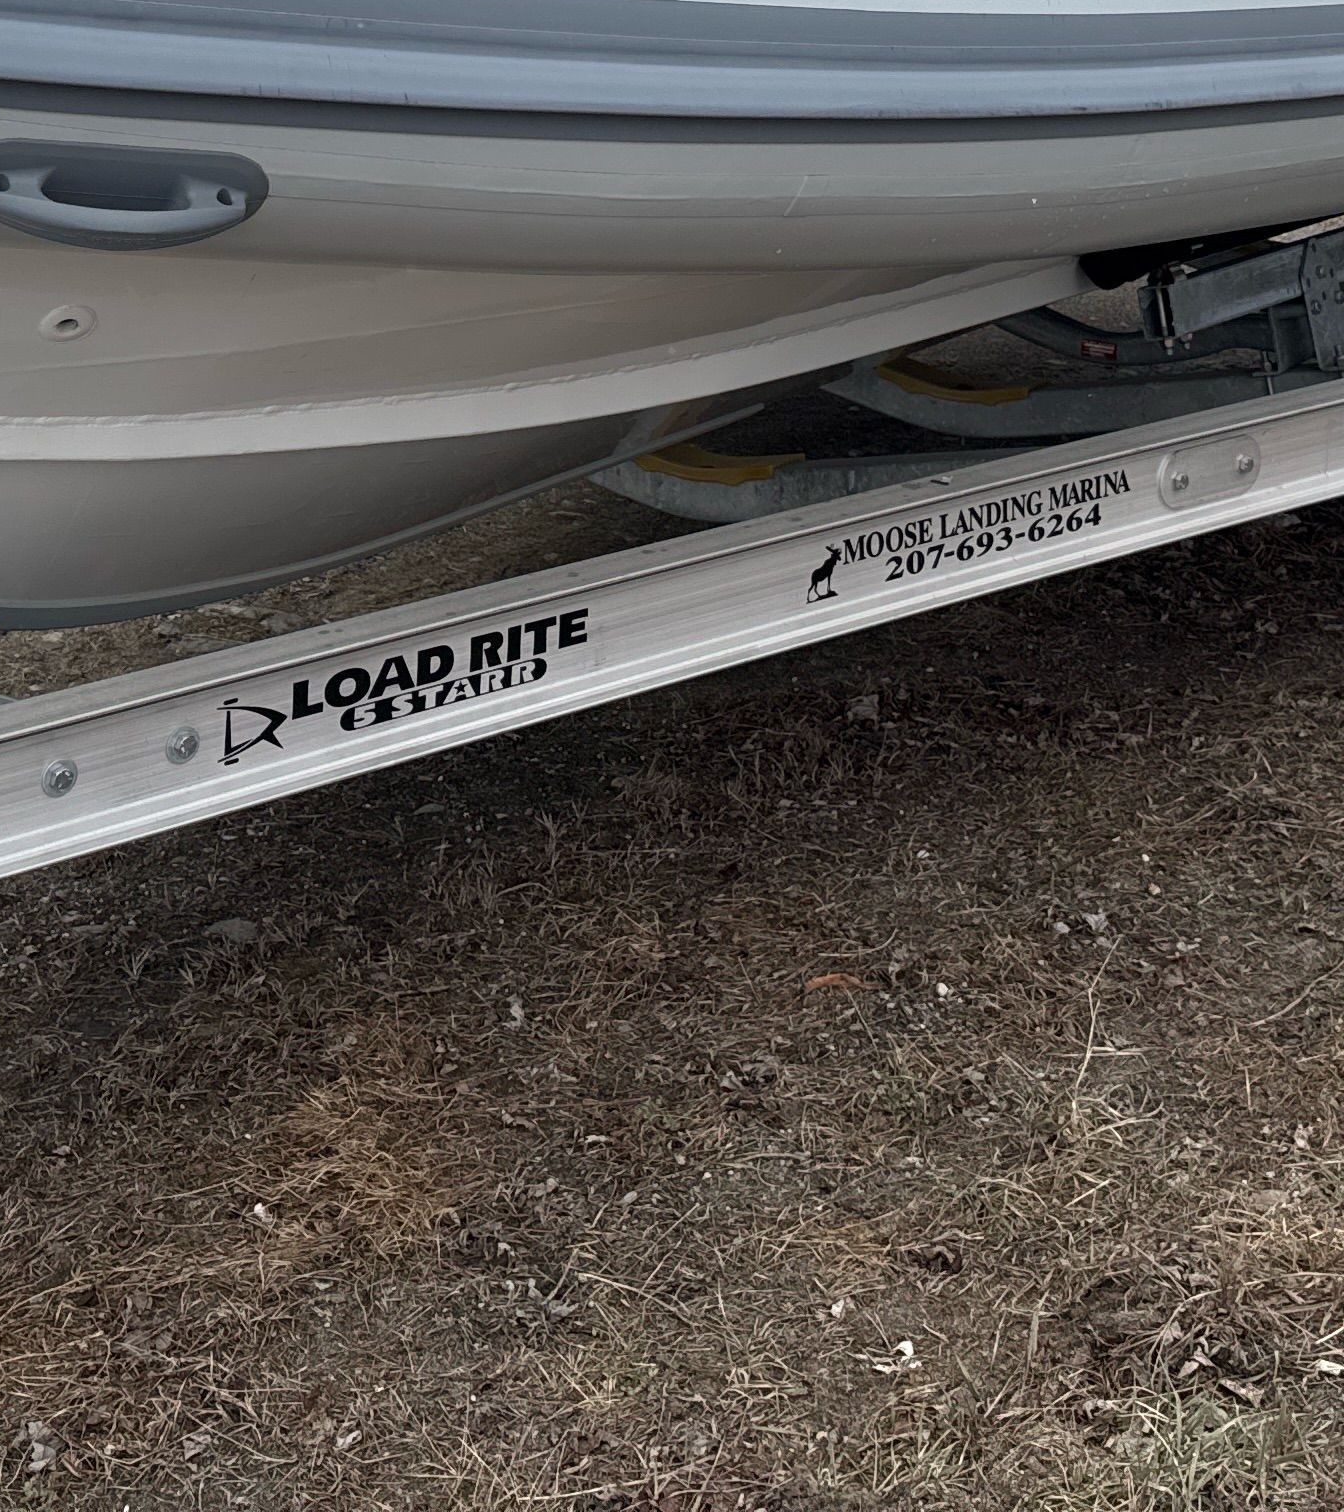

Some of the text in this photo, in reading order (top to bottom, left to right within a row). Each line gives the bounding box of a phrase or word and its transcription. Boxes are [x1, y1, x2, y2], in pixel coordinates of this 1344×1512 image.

[843, 469, 1131, 566] MOOSE LANDING MARINA
[884, 502, 1103, 583] 207-693-6264
[292, 607, 590, 720] LOAD RITE
